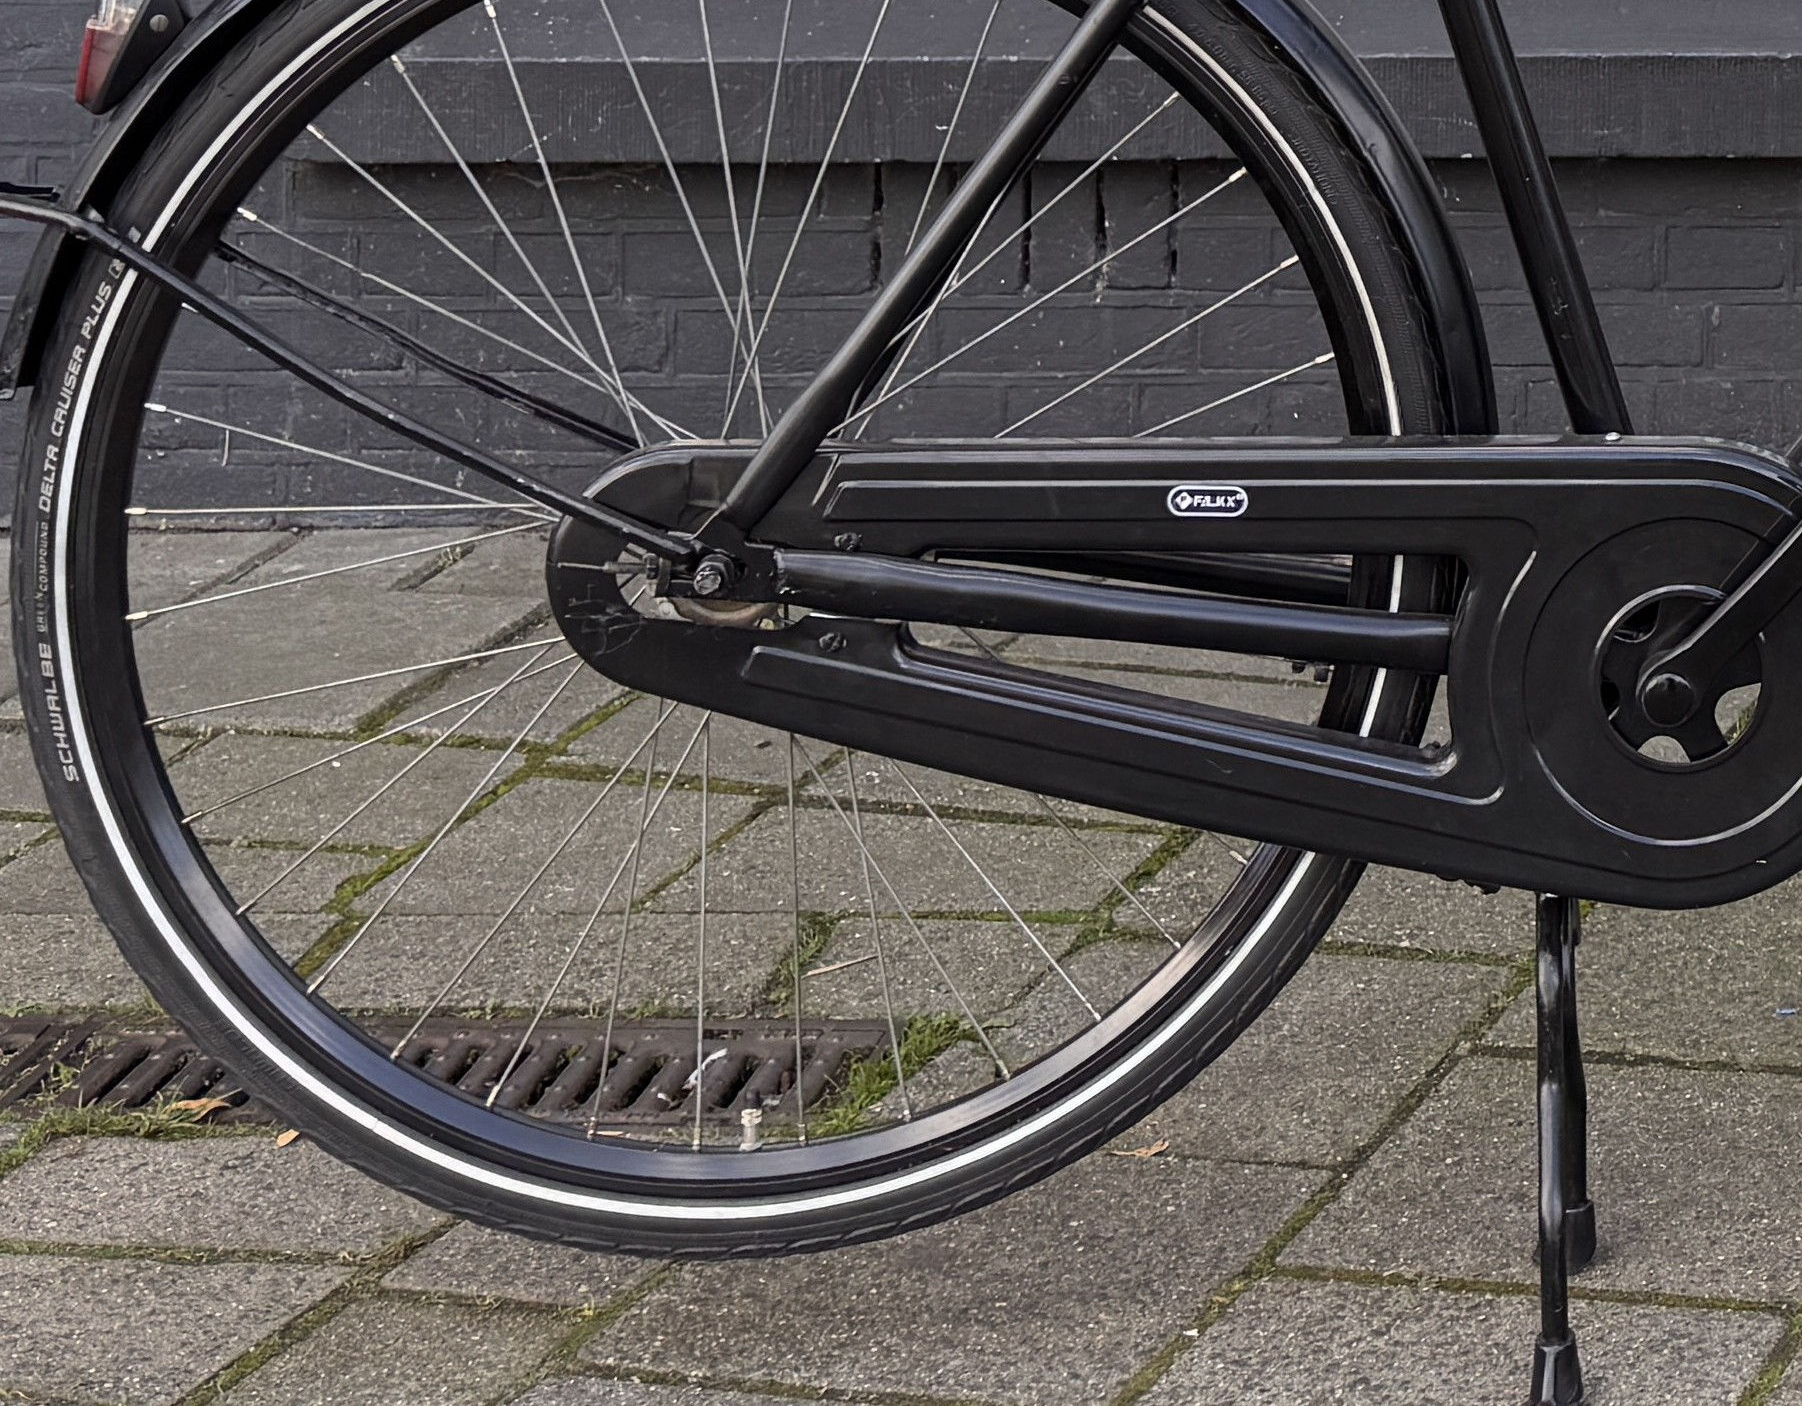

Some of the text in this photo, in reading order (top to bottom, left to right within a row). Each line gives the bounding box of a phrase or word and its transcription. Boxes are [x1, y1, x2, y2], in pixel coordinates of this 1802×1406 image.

[38, 280, 112, 514] DELTA CRUISER PLUS
[38, 521, 49, 592] COMPOUND
[38, 642, 80, 783] SCHWALBE
